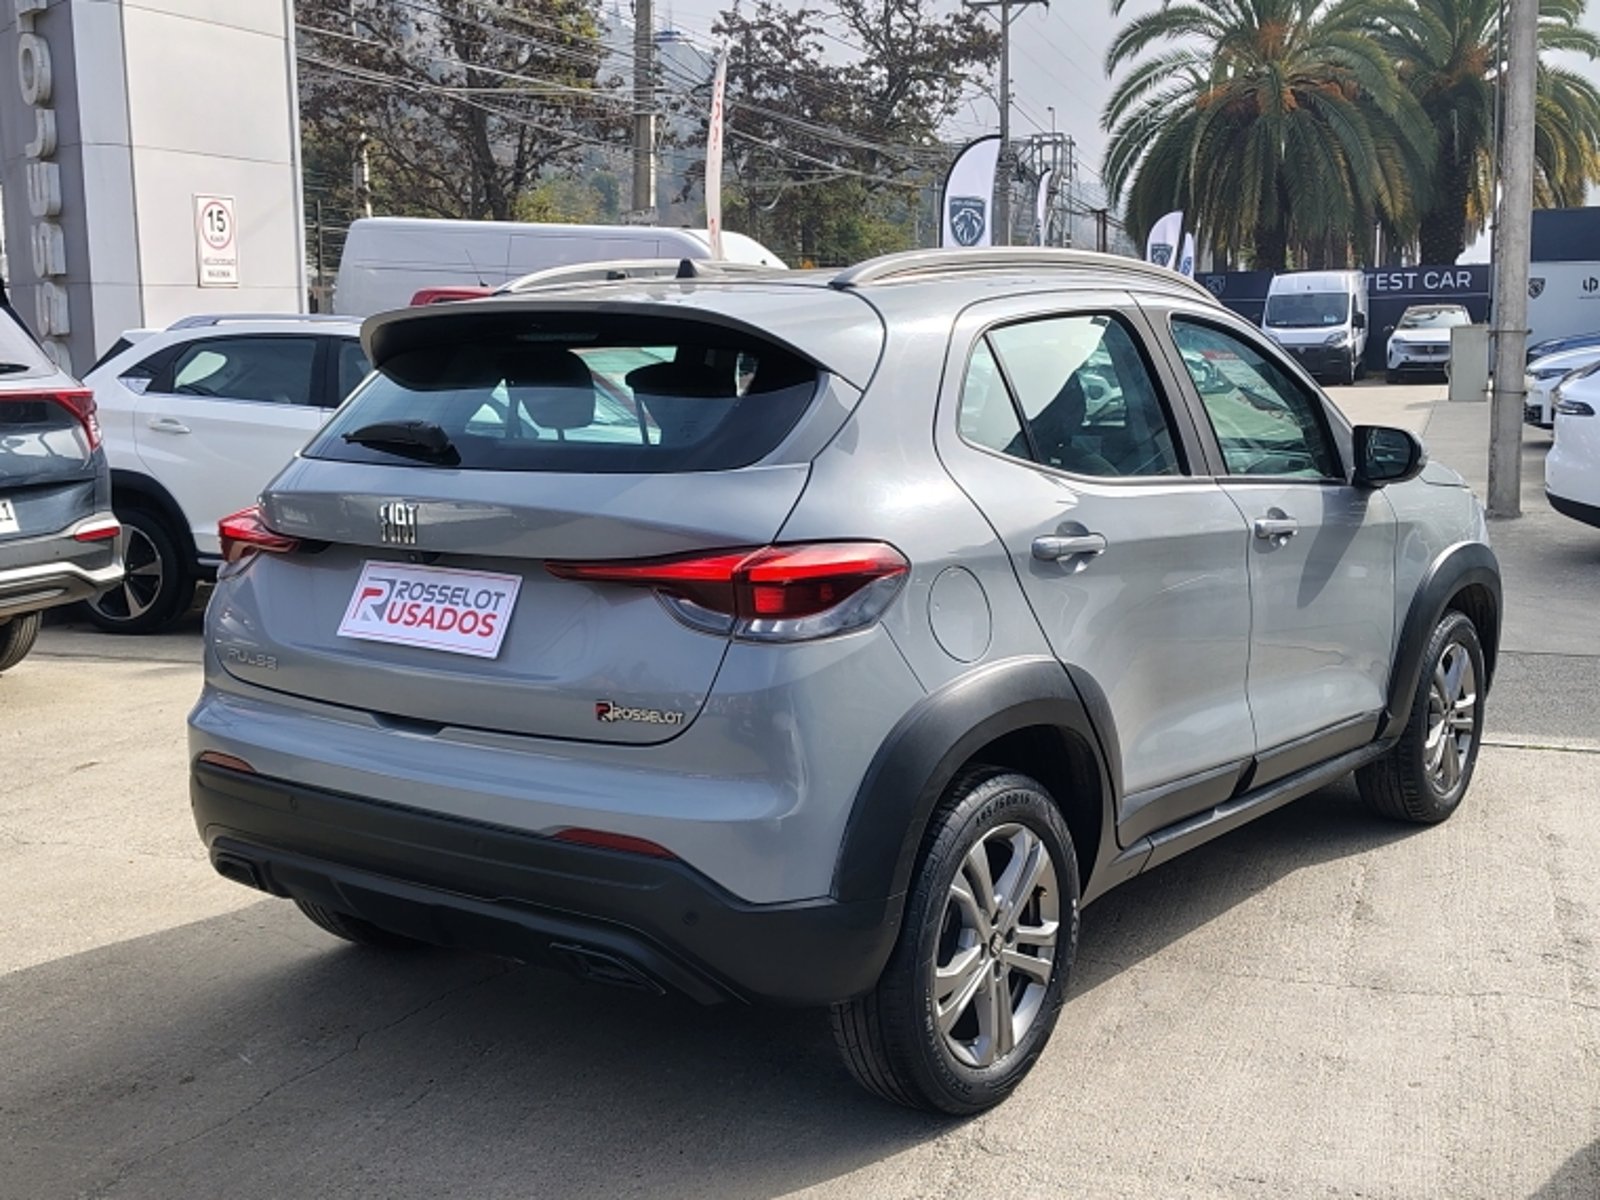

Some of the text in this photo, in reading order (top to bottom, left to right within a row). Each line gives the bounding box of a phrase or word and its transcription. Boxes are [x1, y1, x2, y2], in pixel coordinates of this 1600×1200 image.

[207, 208, 226, 233] 15
[1363, 271, 1472, 290] TEST CAR
[395, 580, 506, 611] ROSSELOT
[387, 602, 497, 637] USADOS
[613, 707, 683, 725] ROSSELOT
